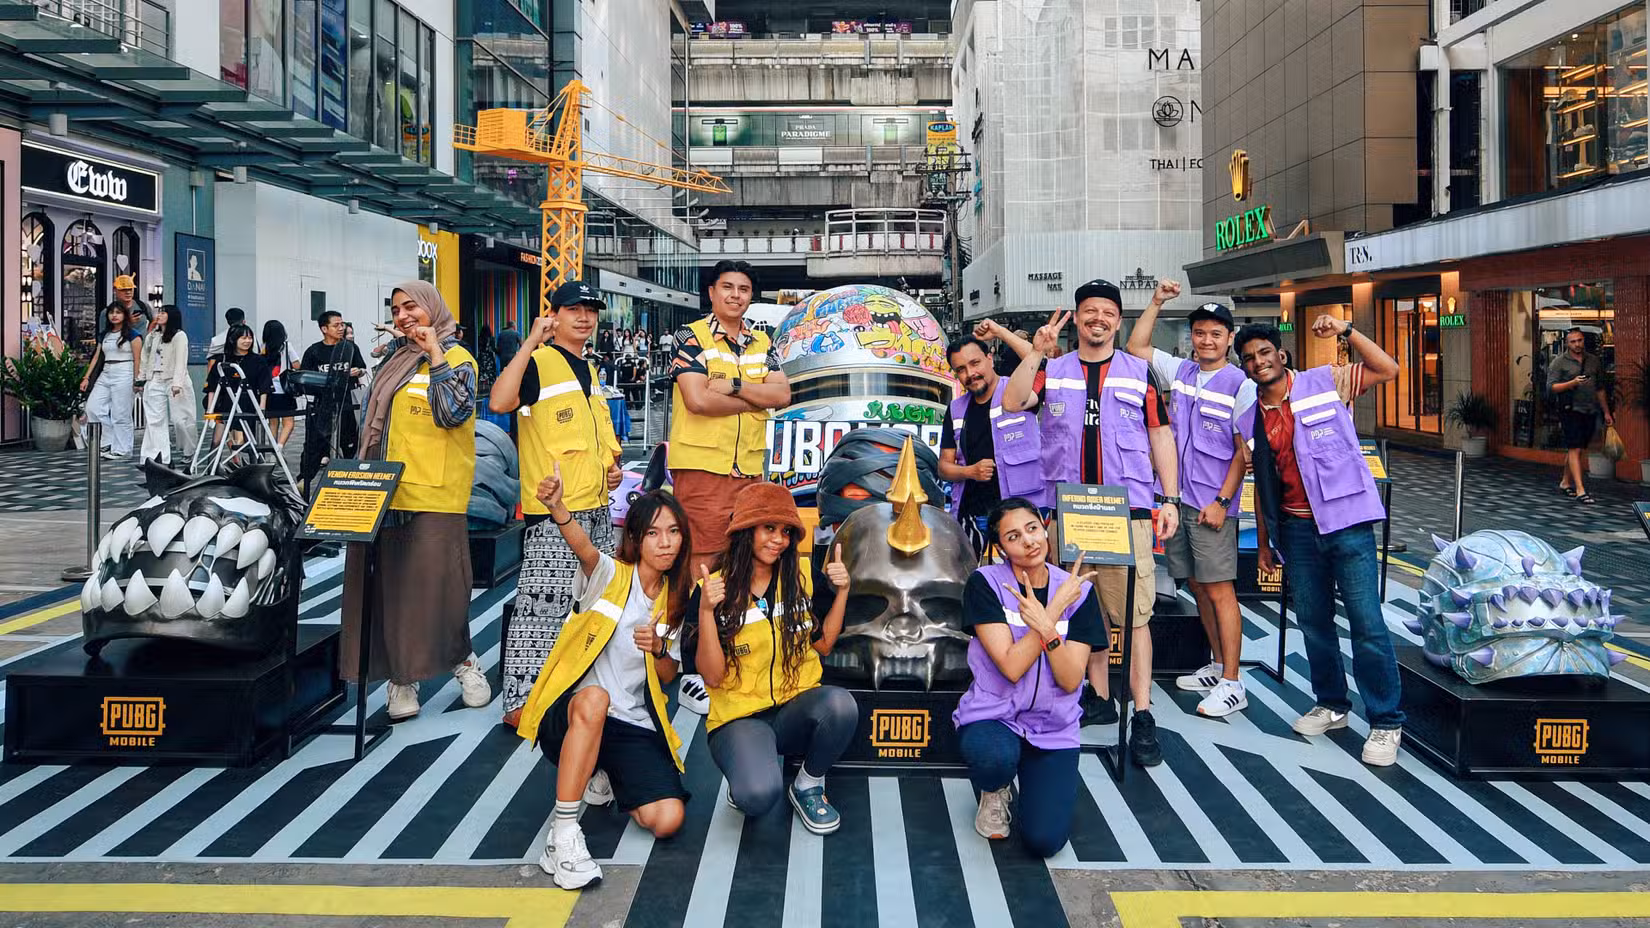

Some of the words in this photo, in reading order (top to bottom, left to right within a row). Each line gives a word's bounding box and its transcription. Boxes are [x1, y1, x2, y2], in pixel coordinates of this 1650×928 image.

[1149, 159, 1179, 170] THAI
[67, 160, 127, 201] Eww
[1216, 205, 1269, 251] ROLEX
[1028, 272, 1062, 280] MASSAGE
[1440, 315, 1465, 326] ROLEX
[327, 470, 348, 478] VENOM
[347, 471, 373, 479] EROSION
[1062, 495, 1086, 503] INFERNO
[1103, 496, 1125, 504] HELMET
[110, 703, 156, 728] PUBG
[879, 716, 922, 740] PUBG
[109, 737, 156, 747] MOBILE
[1542, 725, 1581, 748] PUBG
[878, 748, 921, 758] MOBILE
[1541, 755, 1580, 764] MOBILE
